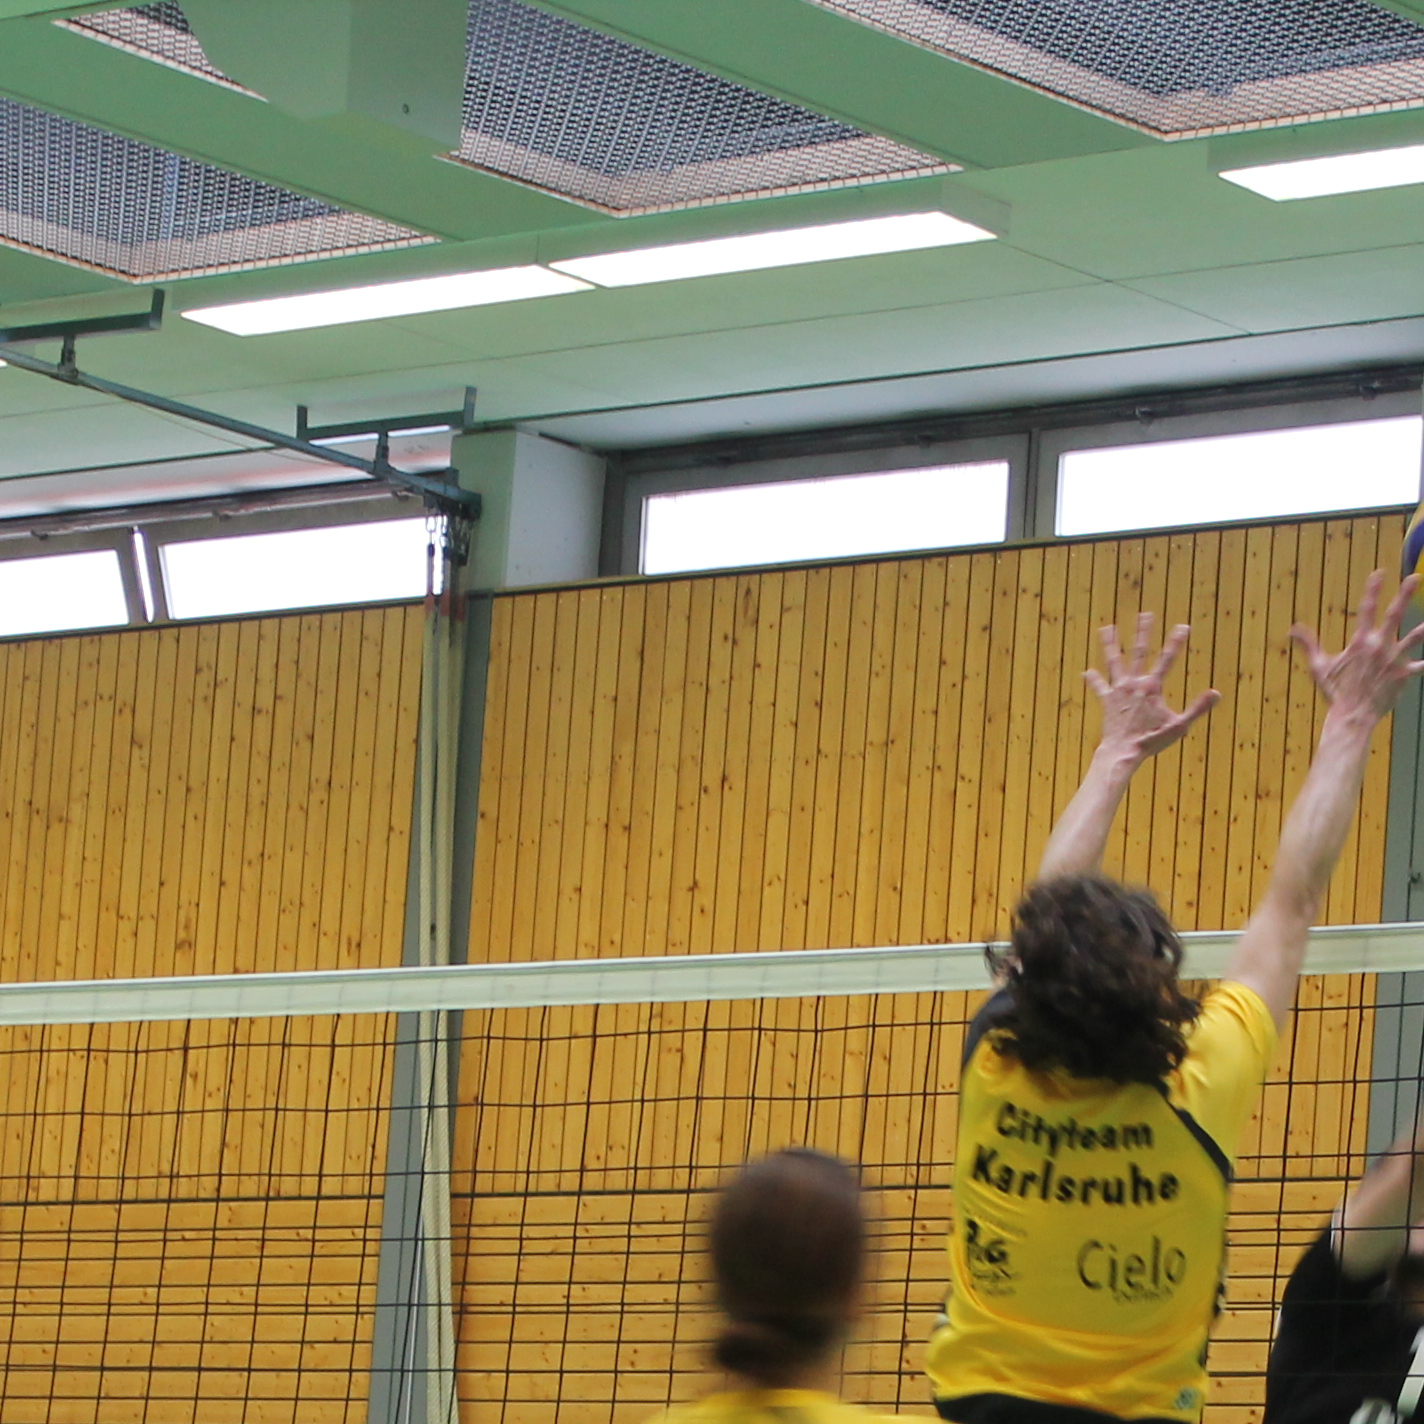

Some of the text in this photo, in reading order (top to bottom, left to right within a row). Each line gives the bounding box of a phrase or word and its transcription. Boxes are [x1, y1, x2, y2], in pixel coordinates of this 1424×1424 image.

[995, 1101, 1155, 1158] Cityteam
[971, 1143, 1180, 1206] Karlsruhe
[1078, 1235, 1186, 1292] Cielo
